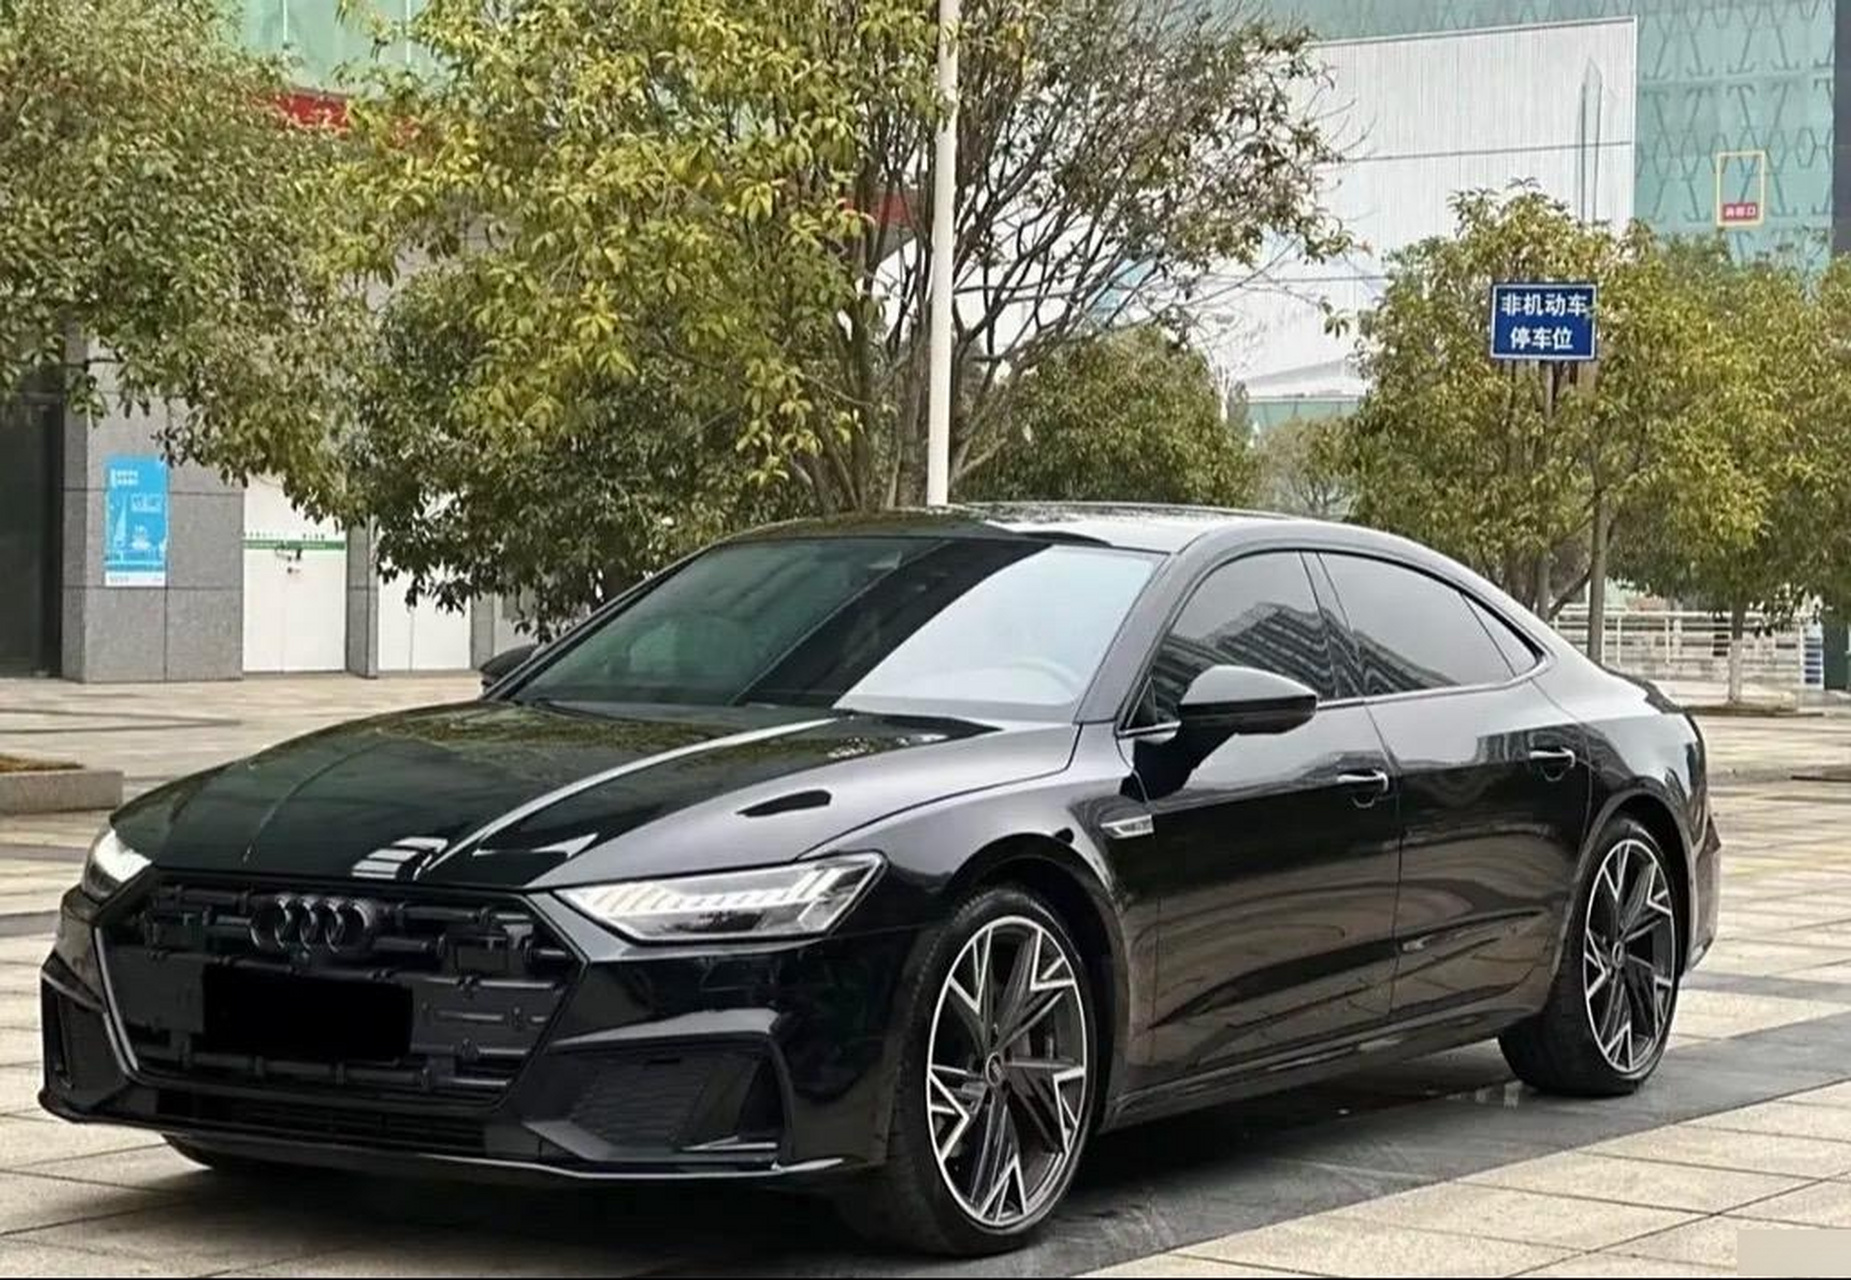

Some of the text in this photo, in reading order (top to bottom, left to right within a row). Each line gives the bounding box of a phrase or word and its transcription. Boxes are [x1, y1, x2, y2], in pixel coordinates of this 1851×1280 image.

[1501, 292, 1588, 317] 非机动车
[1510, 325, 1574, 350] 停车位
